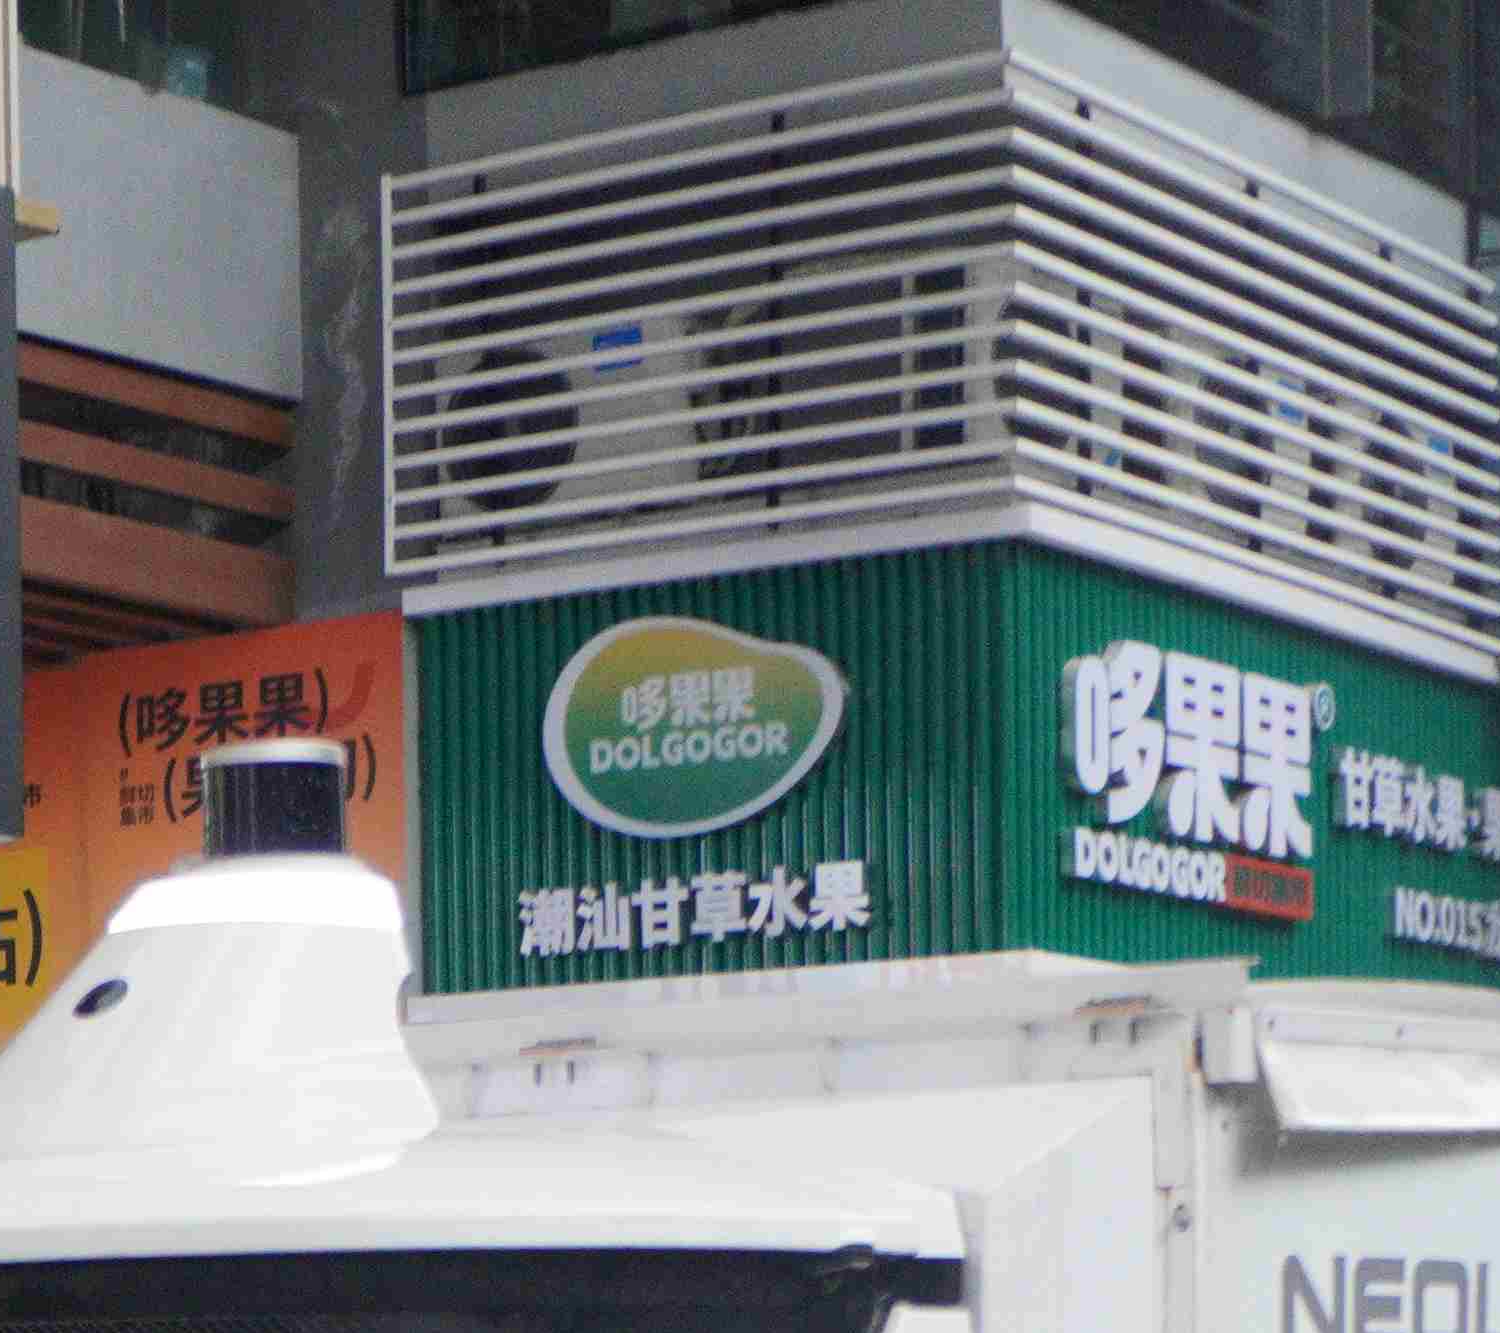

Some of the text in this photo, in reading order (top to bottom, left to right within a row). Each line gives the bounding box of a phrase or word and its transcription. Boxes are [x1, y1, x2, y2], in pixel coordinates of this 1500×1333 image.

[620, 666, 755, 730] 哆果果
[588, 720, 791, 775] DOLGOGOR
[1063, 640, 1313, 860] 哆果果
[1072, 826, 1226, 902] DOLGOGOR
[517, 857, 871, 958] 潮汕甘草水果
